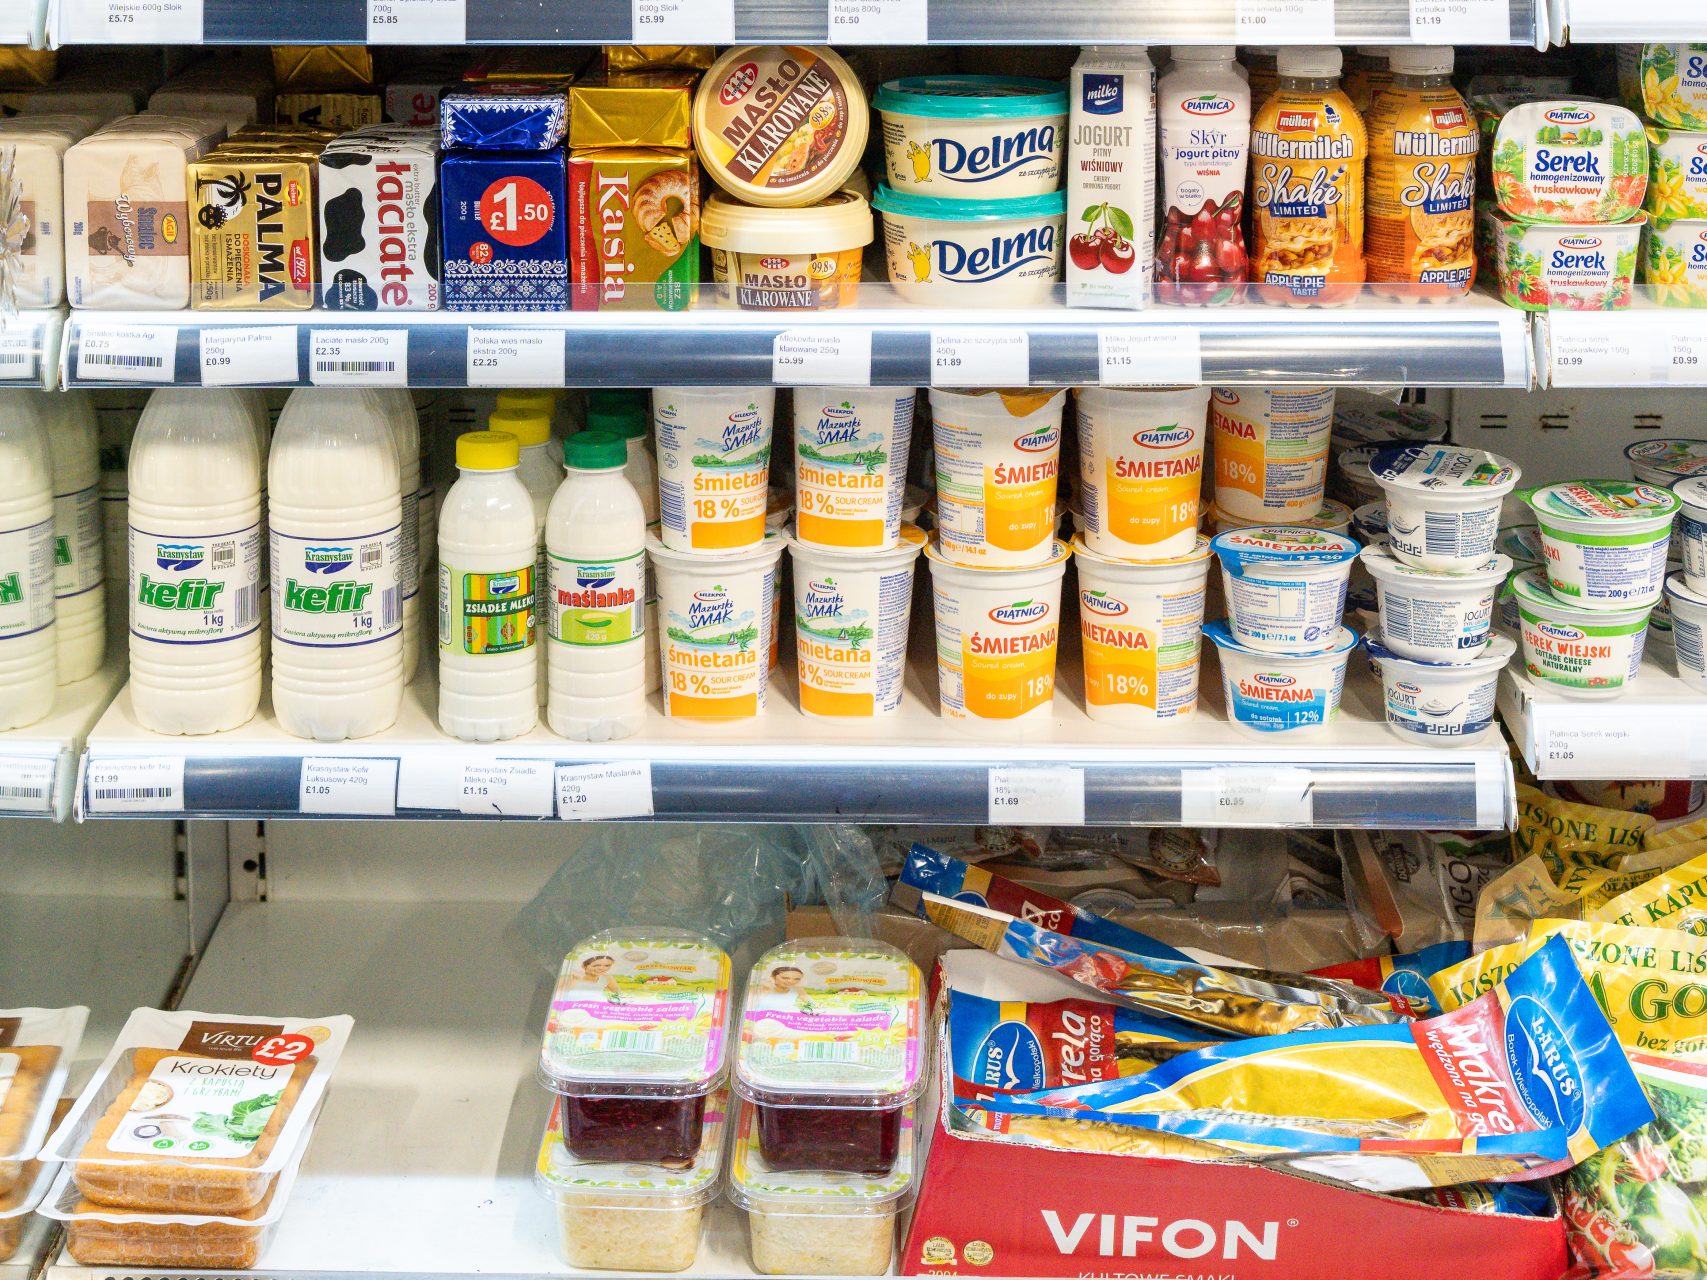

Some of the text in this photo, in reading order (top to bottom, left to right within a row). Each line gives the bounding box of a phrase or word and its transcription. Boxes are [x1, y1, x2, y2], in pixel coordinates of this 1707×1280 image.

[109, 15, 134, 23] £5.75
[373, 16, 398, 24] £5.85
[639, 15, 664, 24] £5.99
[834, 16, 859, 24] £6.50
[1241, 15, 1266, 24] £1.00
[1416, 16, 1441, 25] £1.19
[1087, 84, 1118, 102] milko
[722, 59, 801, 148] MASŁO
[1186, 100, 1230, 112] PIĄTNICA
[736, 70, 830, 175] KLAROWANE
[1280, 116, 1313, 128] müller
[1550, 110, 1590, 122] PIĄTNICA
[1074, 126, 1133, 147] JOGURT
[1190, 128, 1227, 146] Skyr
[932, 126, 1054, 174] Delma
[1093, 148, 1111, 157] PITNY
[1175, 148, 1240, 160] jogurt pitny
[1080, 159, 1123, 173] WIŚNIOWY
[1534, 149, 1600, 175] Serek
[1257, 163, 1342, 207] Shake
[1530, 172, 1605, 184] homogenizowany
[1533, 184, 1602, 197] truskawkowy
[1274, 205, 1319, 216] LIMITED
[255, 173, 286, 301] PALMA
[596, 171, 635, 302] Kasia
[932, 226, 1054, 274] Delma
[1551, 250, 1606, 271] Serek
[744, 274, 806, 288] MASŁO
[1265, 272, 1323, 288] APPLE PIE
[740, 291, 812, 307] KLAROWANE
[85, 340, 110, 348] £0.75
[315, 336, 389, 345] Laciate maslo 200g
[315, 347, 340, 355] £2.35
[206, 357, 230, 365] £0.99
[473, 358, 498, 366] £2.25
[779, 356, 804, 365] £5.99
[936, 358, 961, 366] £1.89
[1558, 357, 1582, 365] £0.99
[1115, 454, 1201, 478] ŚMIETANA
[157, 550, 204, 561] Krasnystaw
[138, 574, 224, 610] kefir
[284, 578, 372, 614] kefir
[558, 586, 635, 607] maślanka
[465, 600, 506, 614] ZSIADŁE
[1524, 631, 1611, 658] SEREK WIEJSKI
[669, 645, 756, 668] śmietana
[1542, 659, 1583, 673] NATURALNY
[1106, 673, 1148, 695] 18%
[1239, 681, 1313, 702] ŚMIETANA
[1294, 710, 1319, 724] 12%
[1550, 751, 1574, 759] £1.05
[95, 775, 118, 783] £1.99
[305, 786, 330, 794] £1.05
[463, 787, 488, 796] £1.15
[563, 795, 587, 804] £1.20
[994, 797, 1019, 806] £1.69
[572, 1002, 690, 1014] Fresh vegetable salads
[1636, 1030, 1668, 1051] bez
[255, 1037, 307, 1061] £2
[1427, 1030, 1460, 1088] wędzona
[1534, 1016, 1577, 1097] LARUS
[170, 1061, 278, 1080] Krokiety
[1507, 1033, 1553, 1128] Borek Wielkopolski
[1041, 1210, 1280, 1260] VIFON
